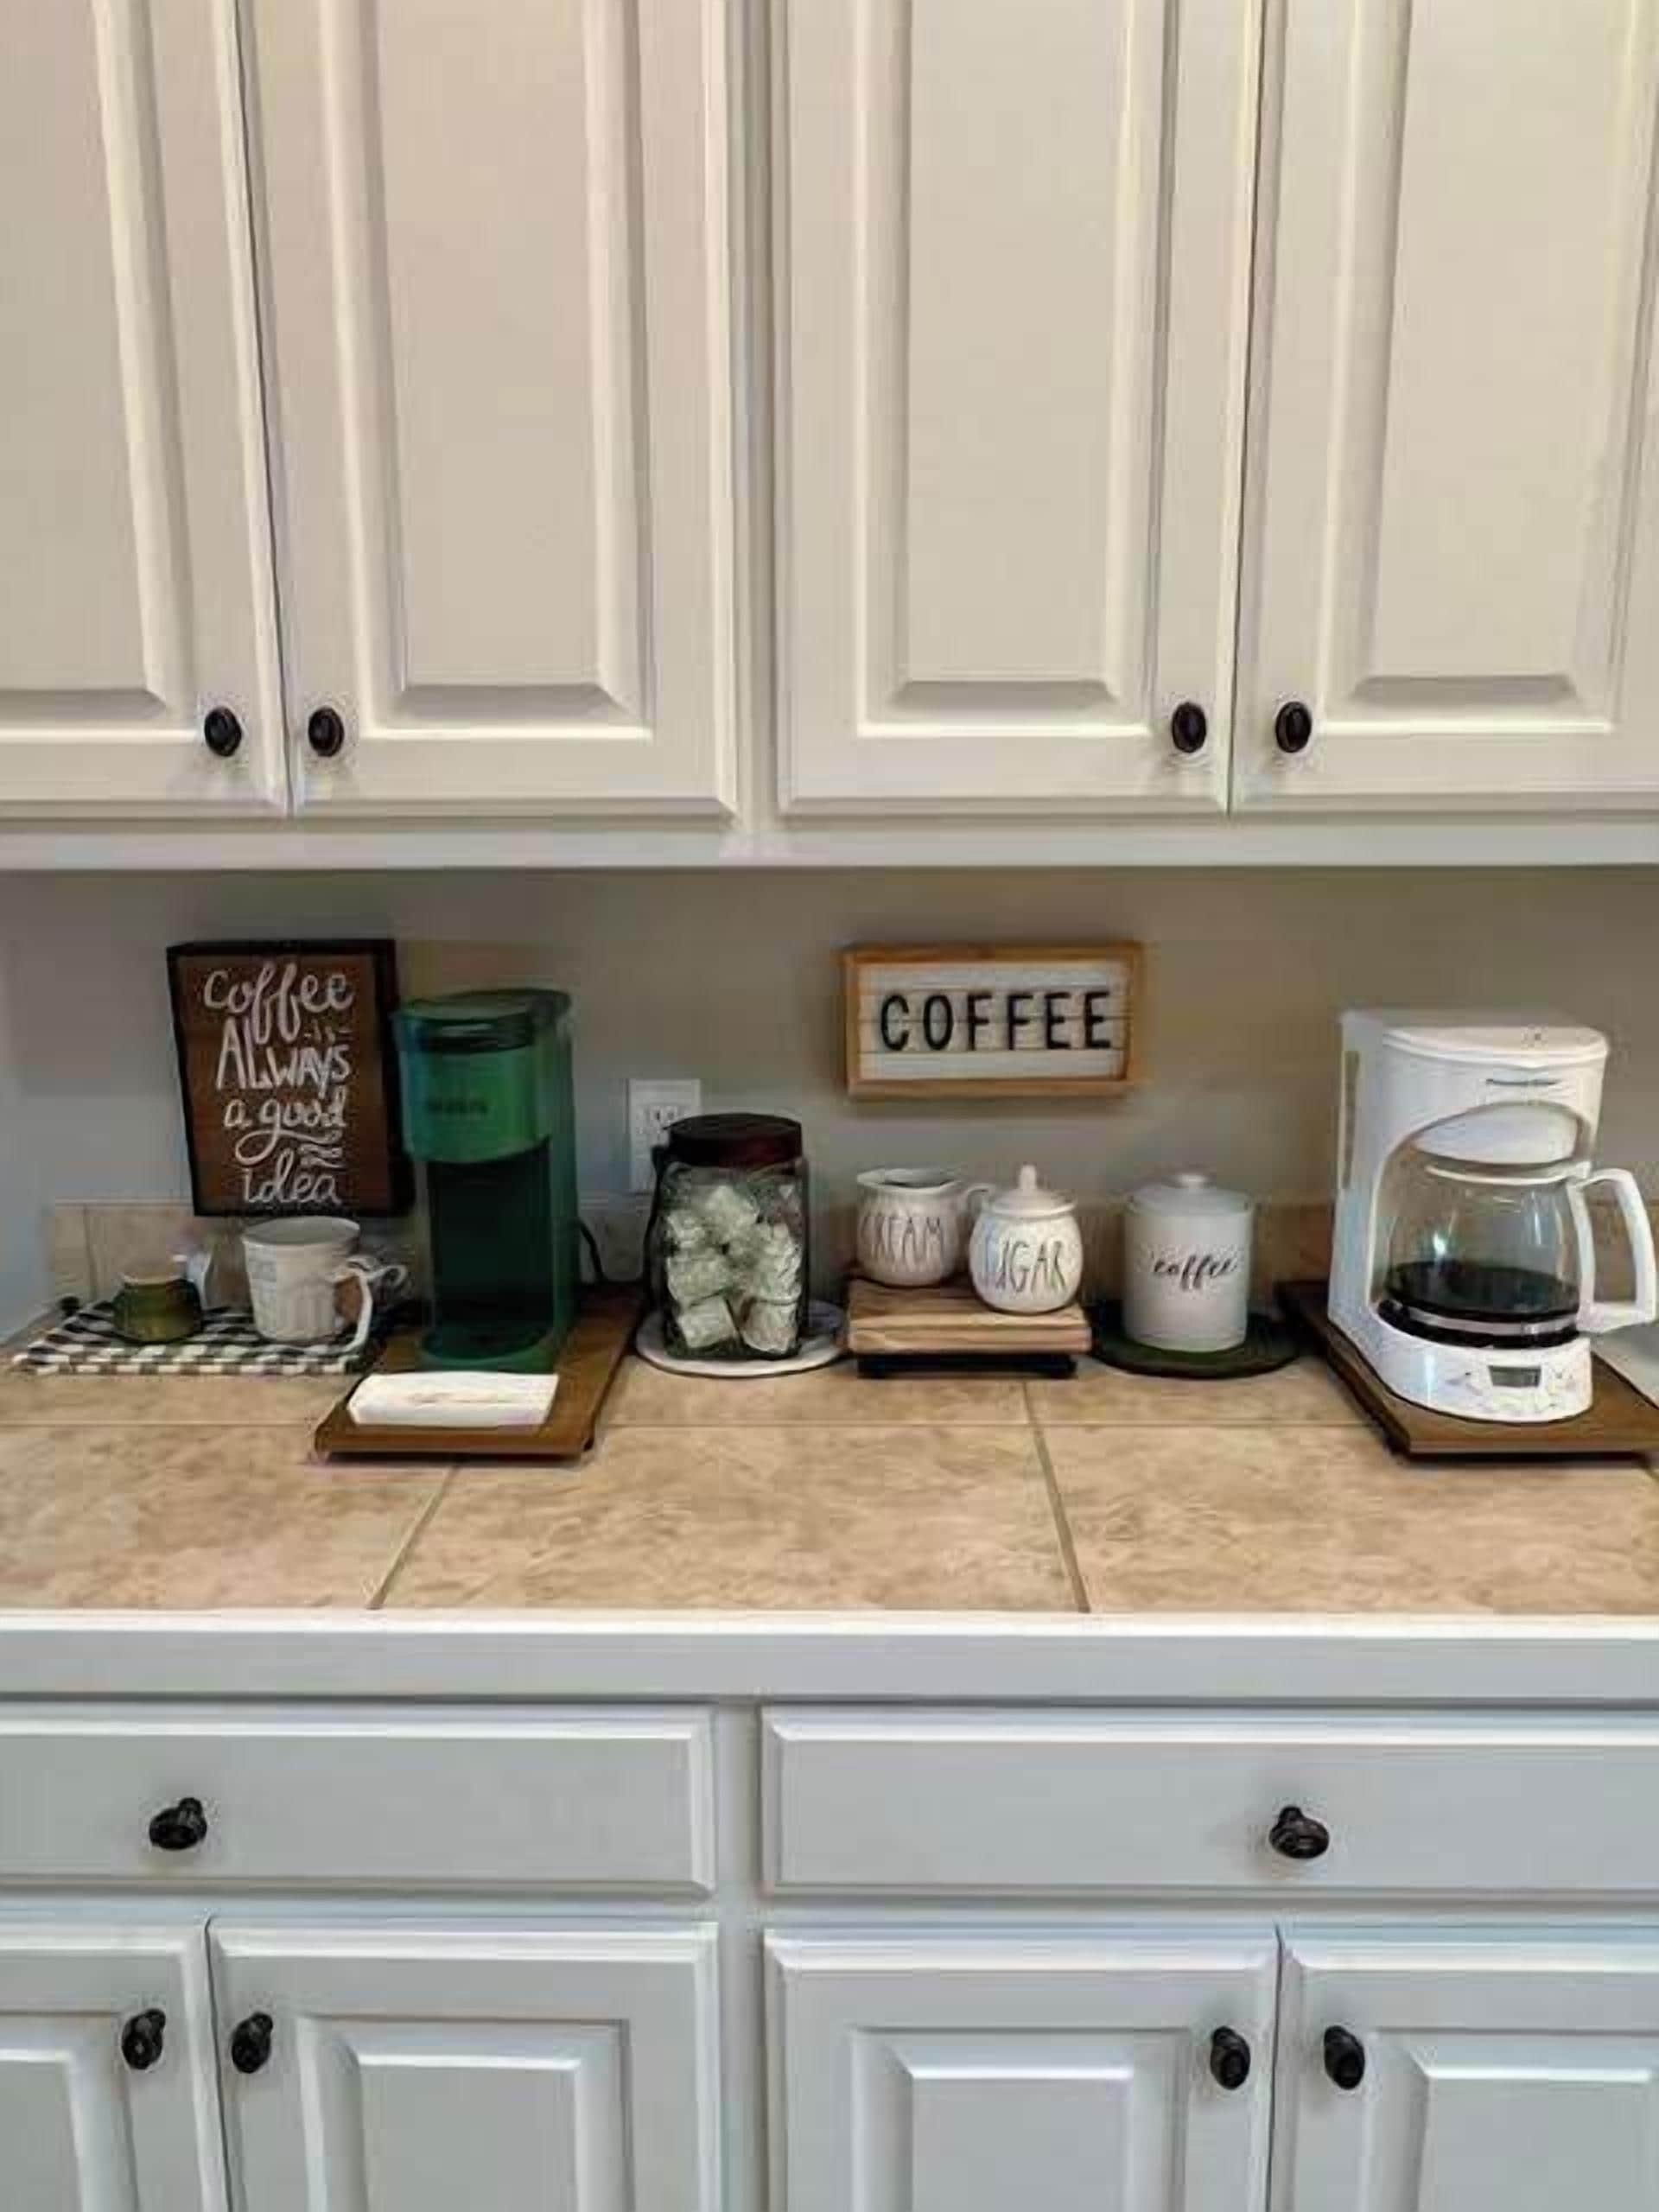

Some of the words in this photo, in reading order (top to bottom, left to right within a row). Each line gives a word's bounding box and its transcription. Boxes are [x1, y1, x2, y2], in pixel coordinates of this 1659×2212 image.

[880, 991, 1112, 1052] COFFEE
[216, 1017, 351, 1099] ALWAYS
[224, 1098, 253, 1128] a
[1153, 1254, 1238, 1292] coffee
